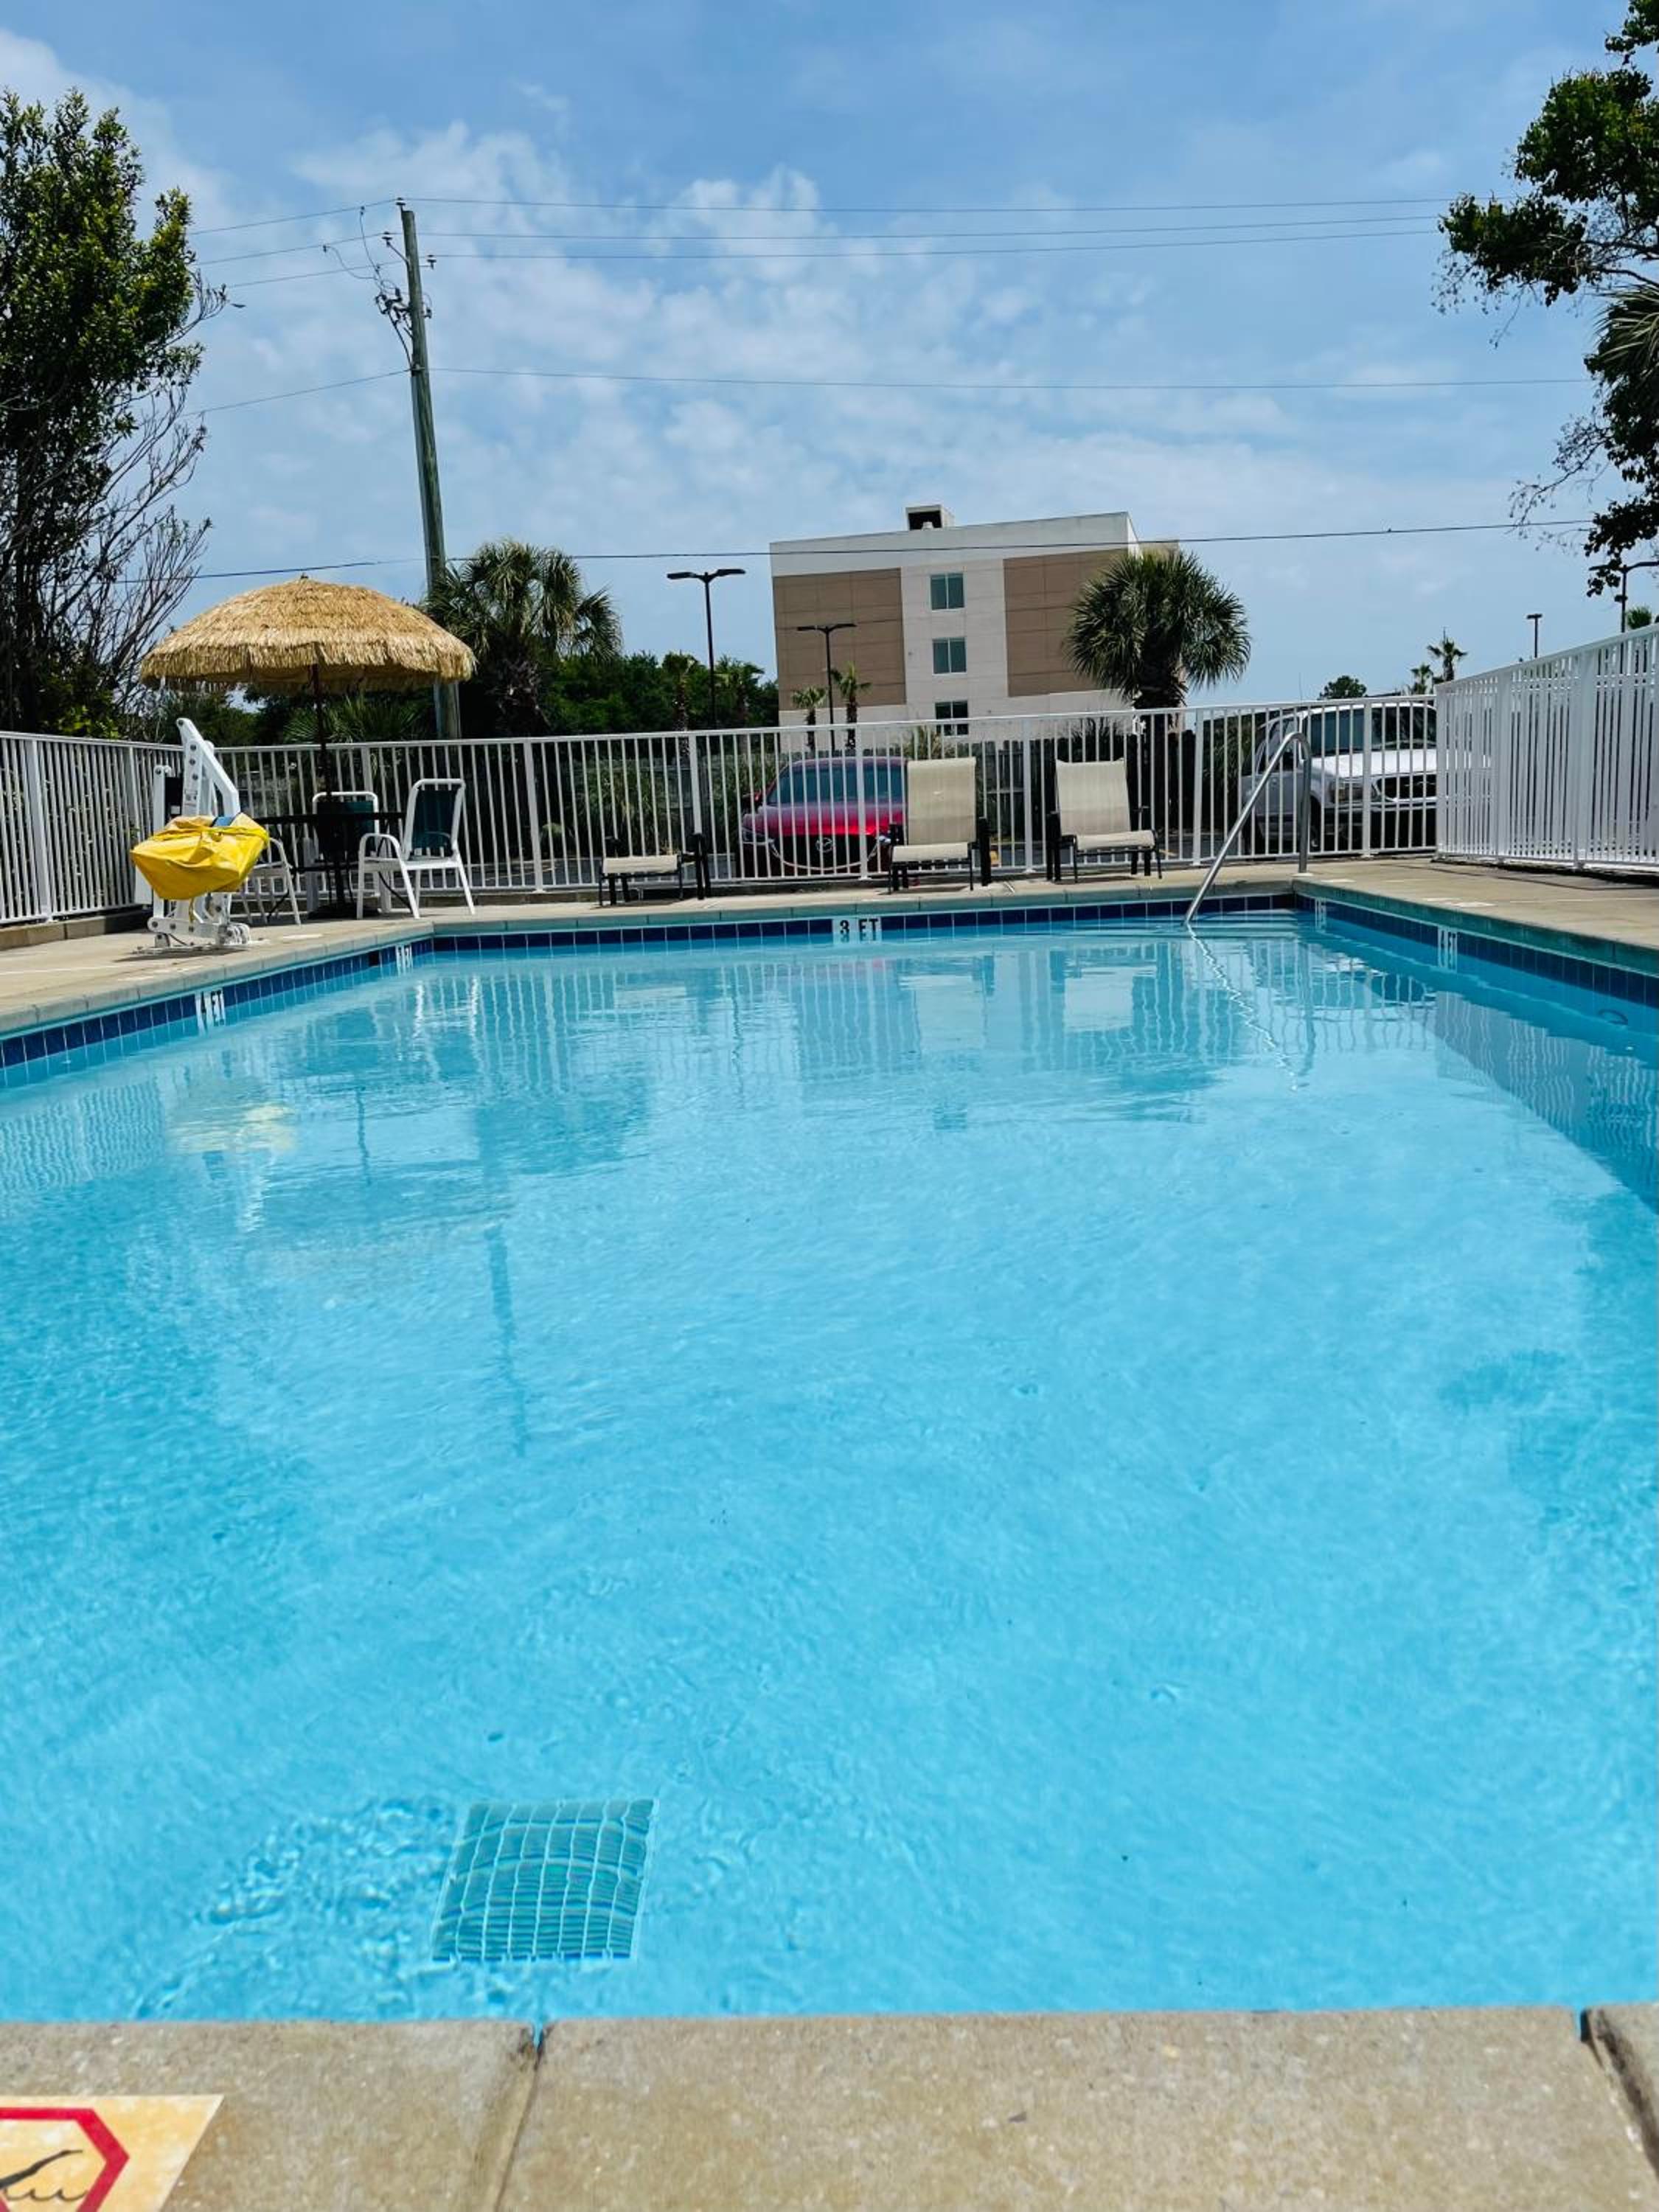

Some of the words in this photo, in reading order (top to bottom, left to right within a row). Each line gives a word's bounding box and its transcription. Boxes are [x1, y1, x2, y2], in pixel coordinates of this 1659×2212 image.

[839, 919, 850, 936] 3
[858, 918, 878, 936] FT
[210, 989, 223, 1017] FT
